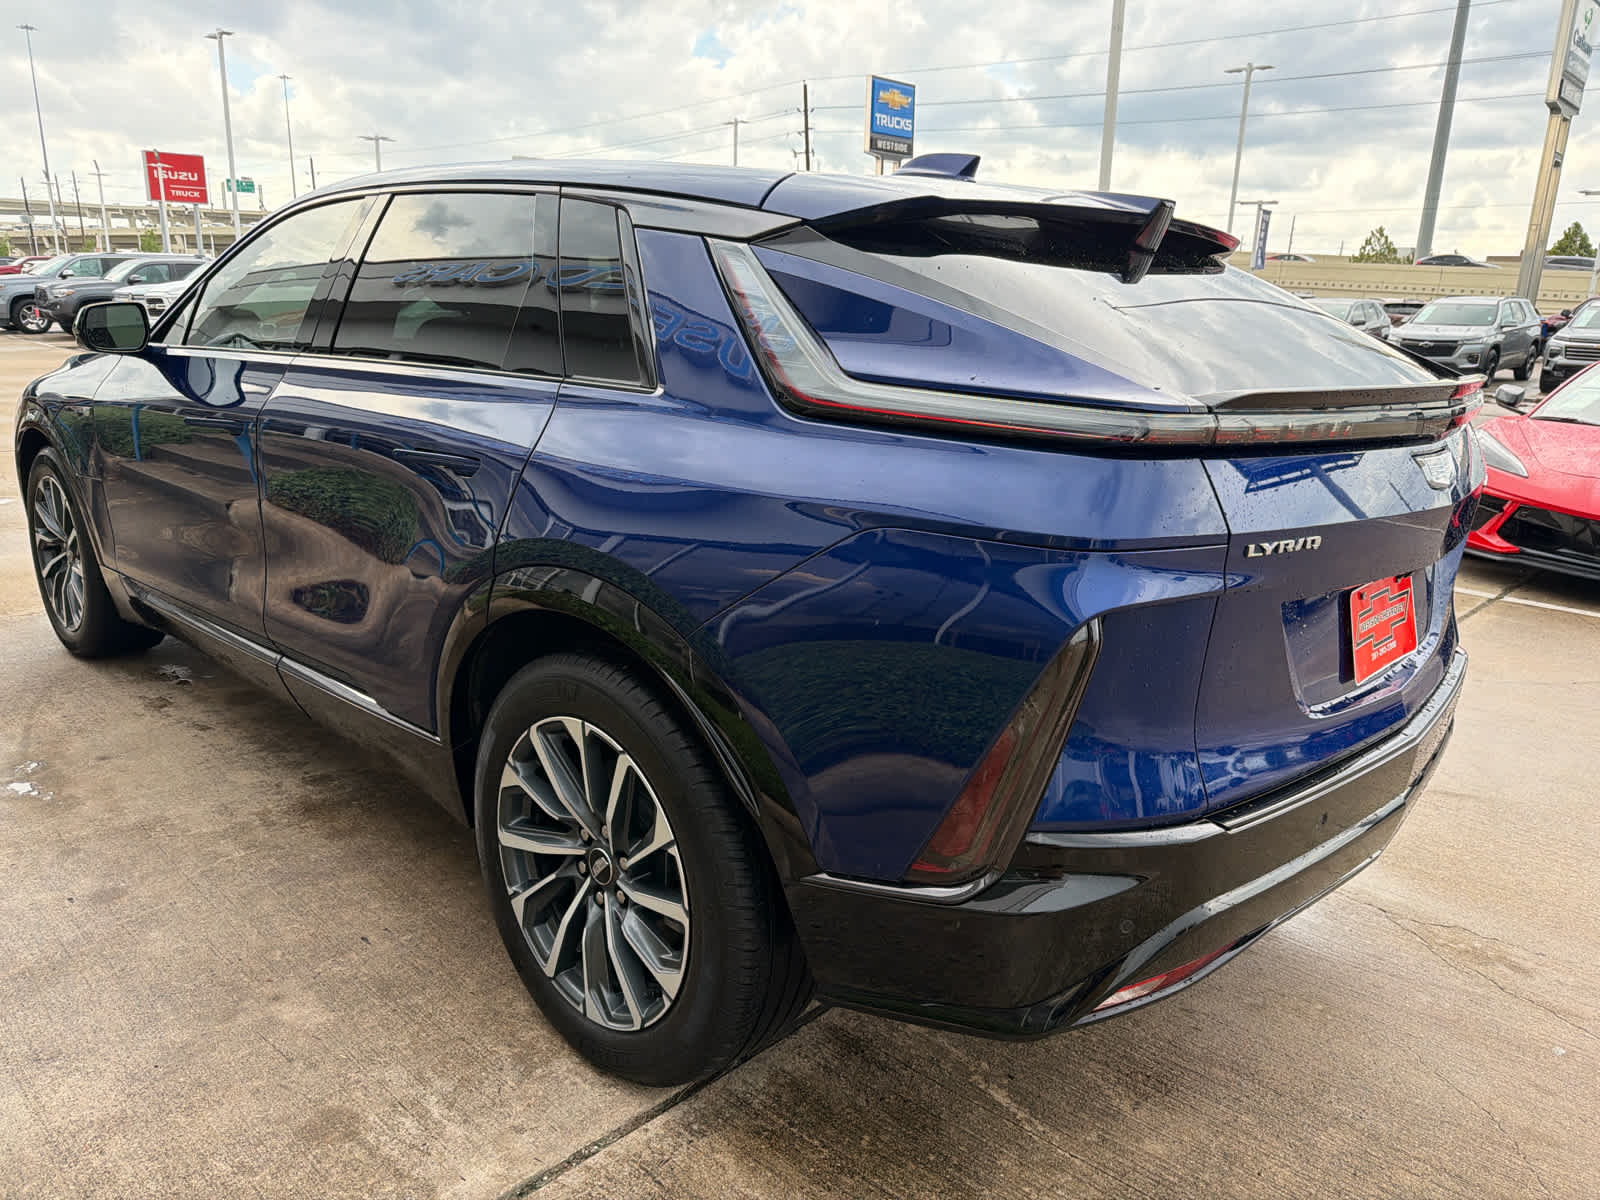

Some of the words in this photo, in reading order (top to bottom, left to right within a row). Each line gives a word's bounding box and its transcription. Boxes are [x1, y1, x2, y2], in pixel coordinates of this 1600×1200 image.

[875, 112, 912, 131] TRUCKS
[877, 140, 908, 152] WESTSIDE
[153, 169, 198, 181] ISUZU
[169, 190, 200, 198] TRUCK
[1246, 535, 1322, 558] LYRIQ
